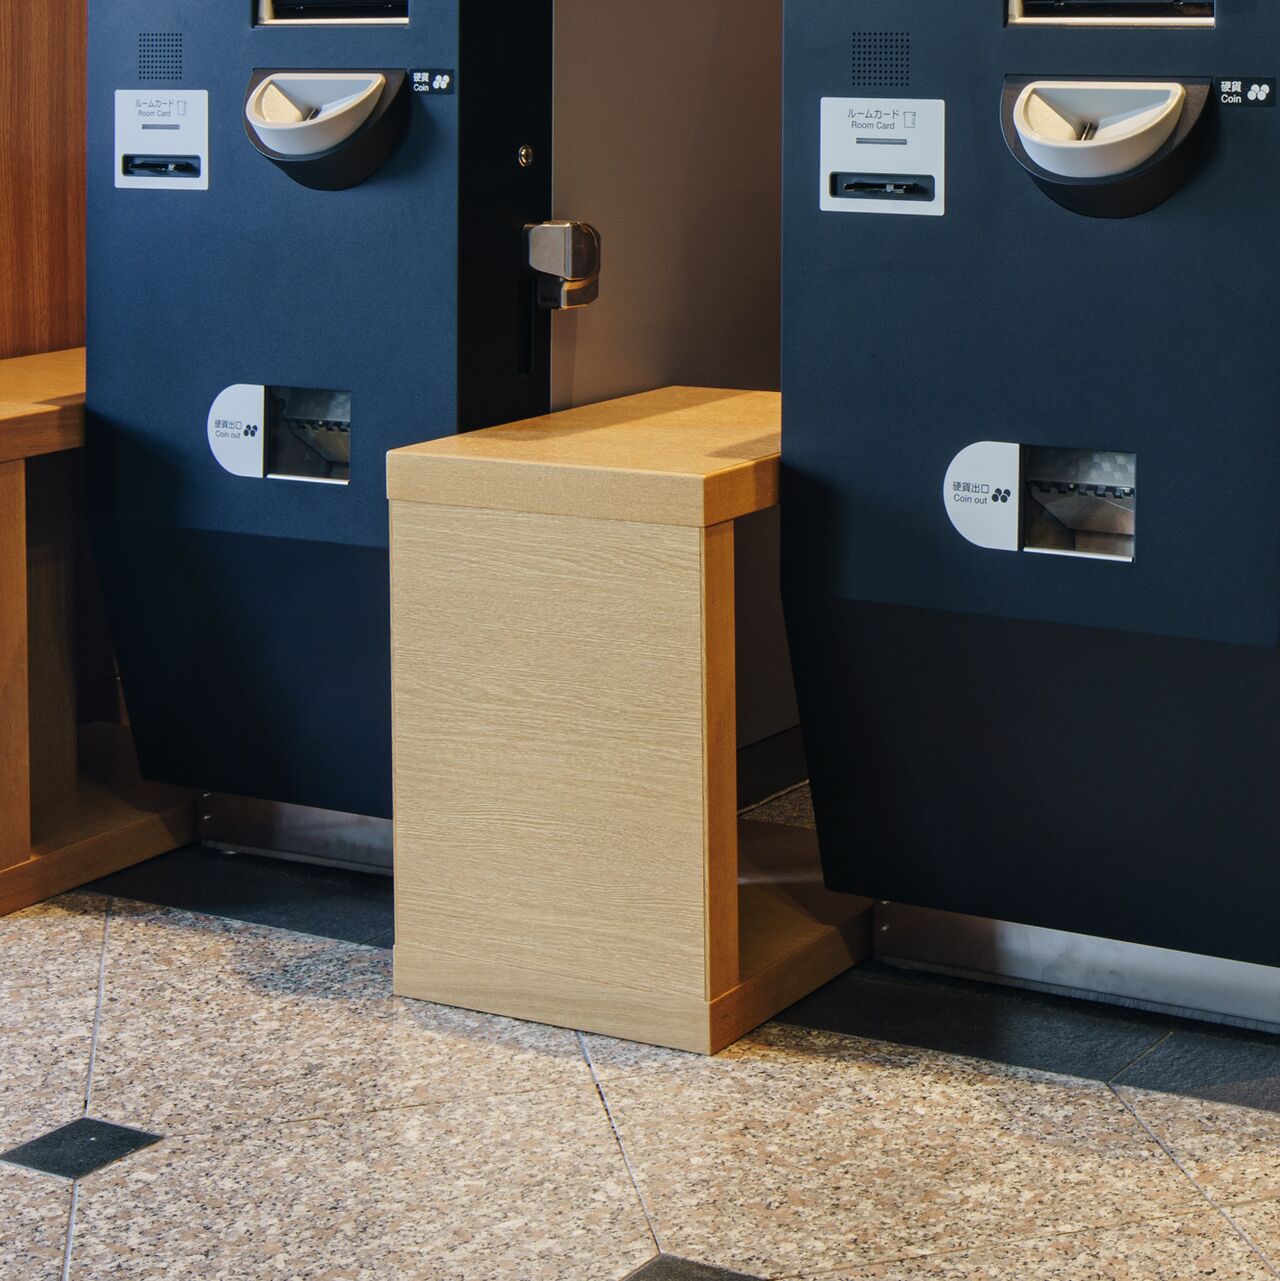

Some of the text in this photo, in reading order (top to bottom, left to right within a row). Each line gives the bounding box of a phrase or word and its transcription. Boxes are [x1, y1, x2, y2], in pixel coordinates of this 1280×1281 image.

[413, 83, 430, 92] Coin
[1220, 81, 1242, 93] 硬貨
[135, 99, 175, 108] ルームカード
[1220, 94, 1242, 104] Coin
[138, 109, 172, 118] Room Card
[847, 108, 900, 120] ルームカード
[851, 120, 896, 130] Room Card
[215, 430, 230, 439] Coin
[952, 481, 990, 494] 硬貨出口
[953, 493, 988, 505] Coin out
